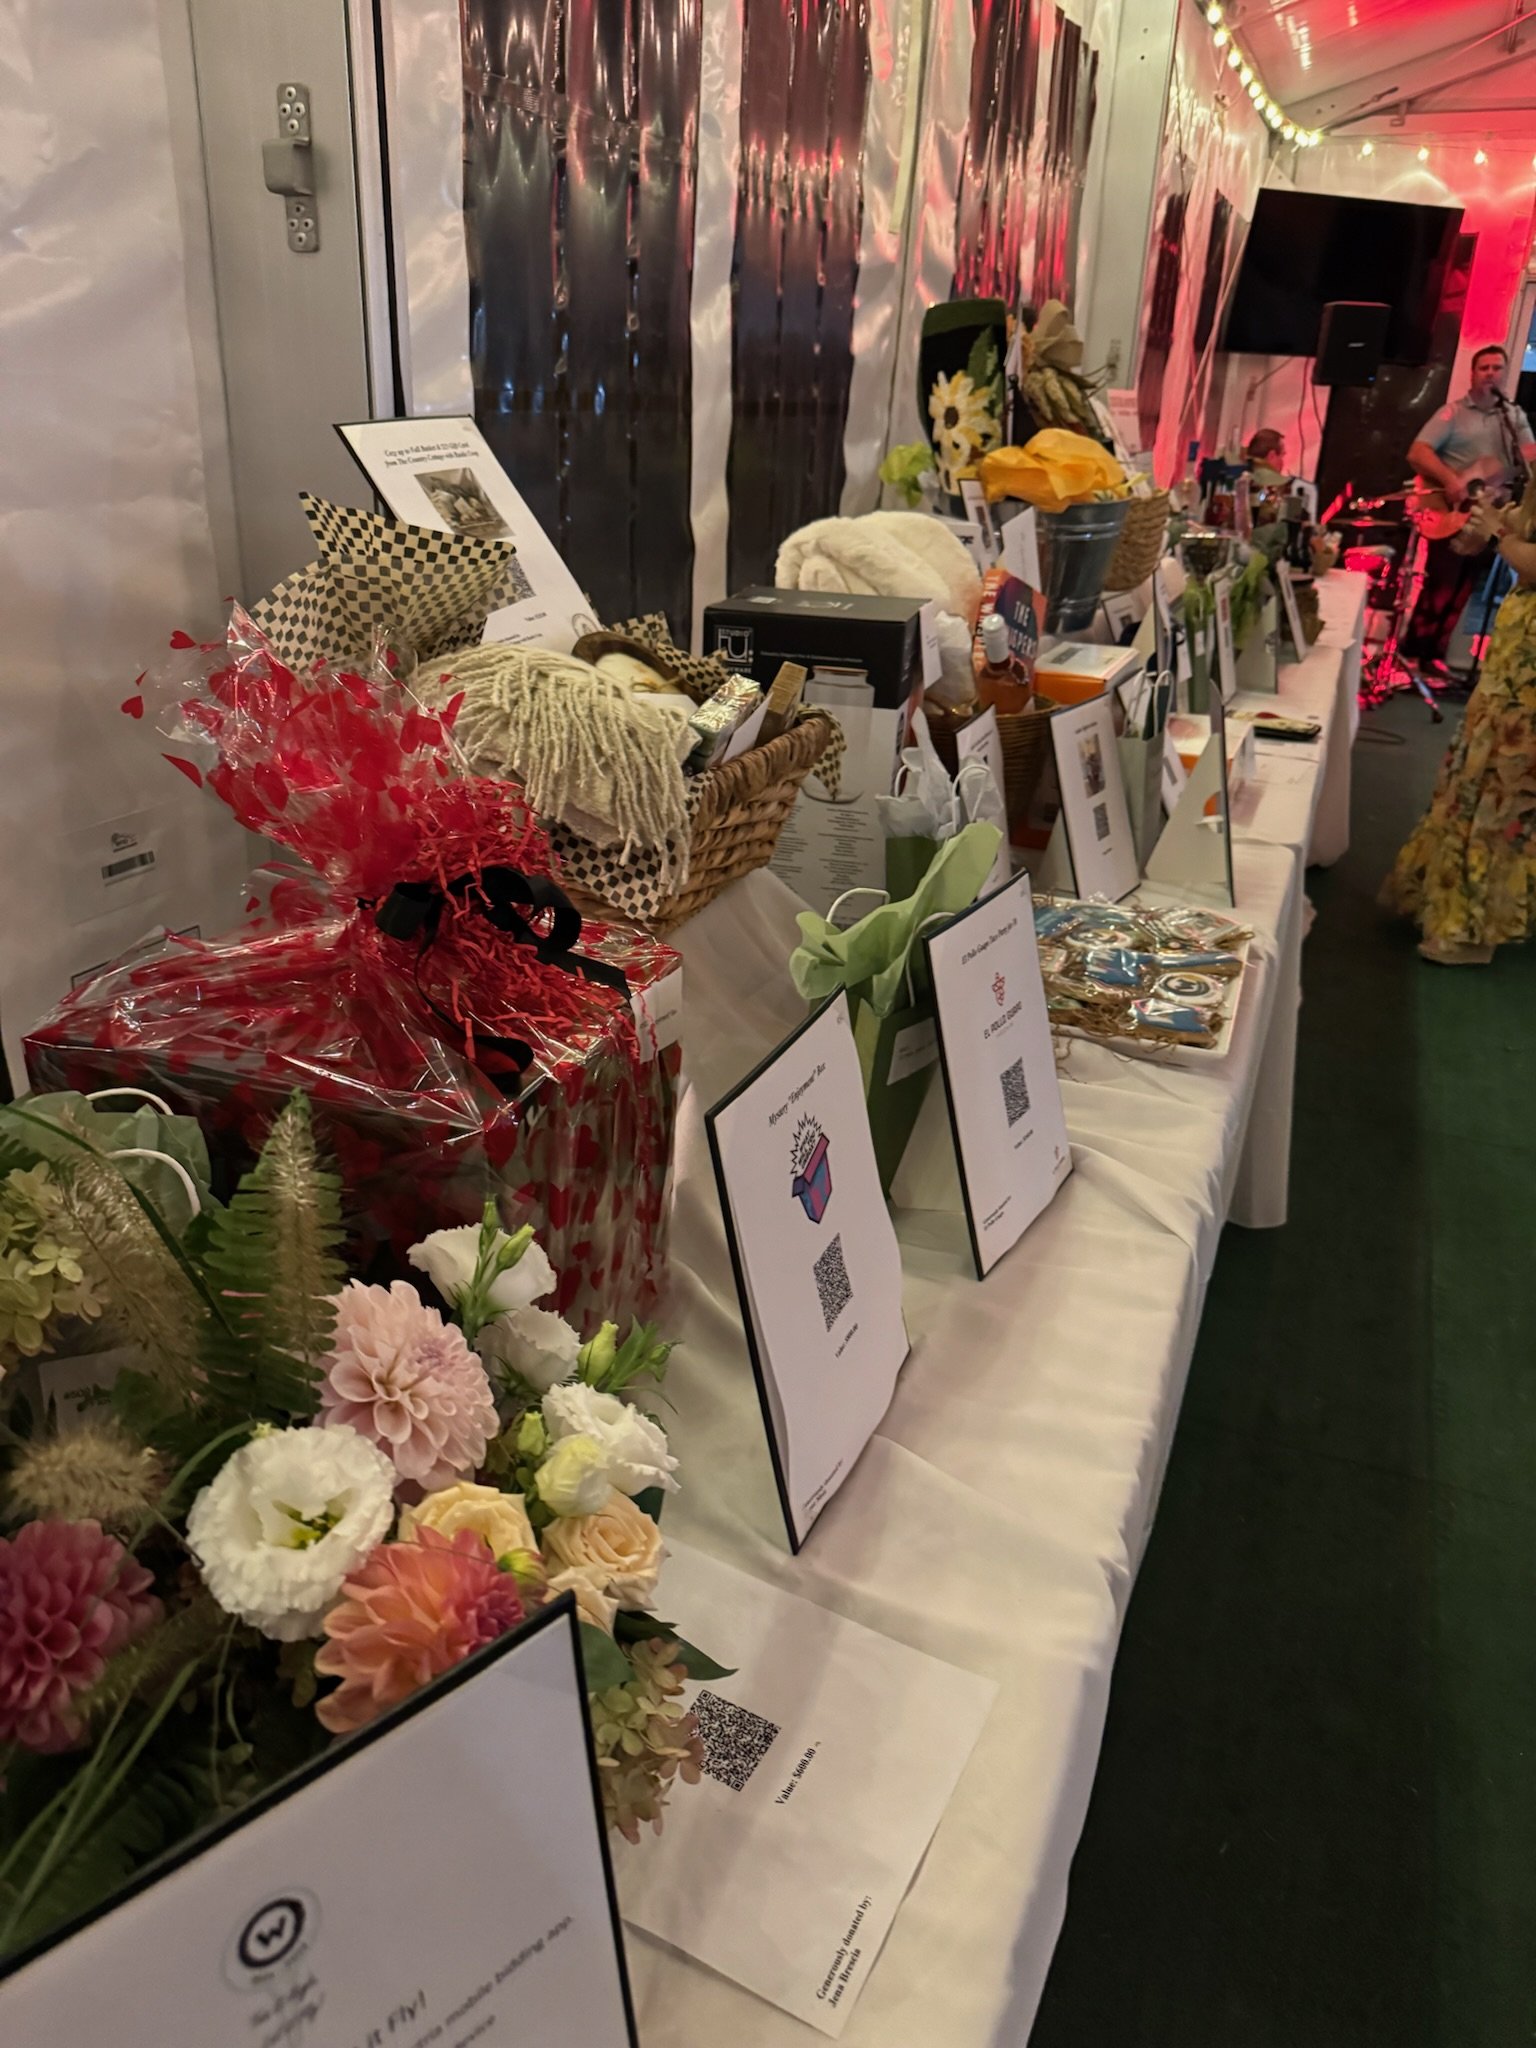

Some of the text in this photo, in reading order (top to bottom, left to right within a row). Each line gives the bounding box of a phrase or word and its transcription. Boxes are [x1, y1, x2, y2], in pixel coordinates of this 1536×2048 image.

[983, 576, 1000, 599] THE
[1014, 601, 1031, 627] THE
[774, 1747, 817, 1804] Value: $600.00
[816, 1895, 873, 2000] Generously donated by:
[446, 1980, 493, 2026] mobile
[495, 1937, 545, 1984] bidding
[828, 1947, 861, 2008] Jena Brescia
